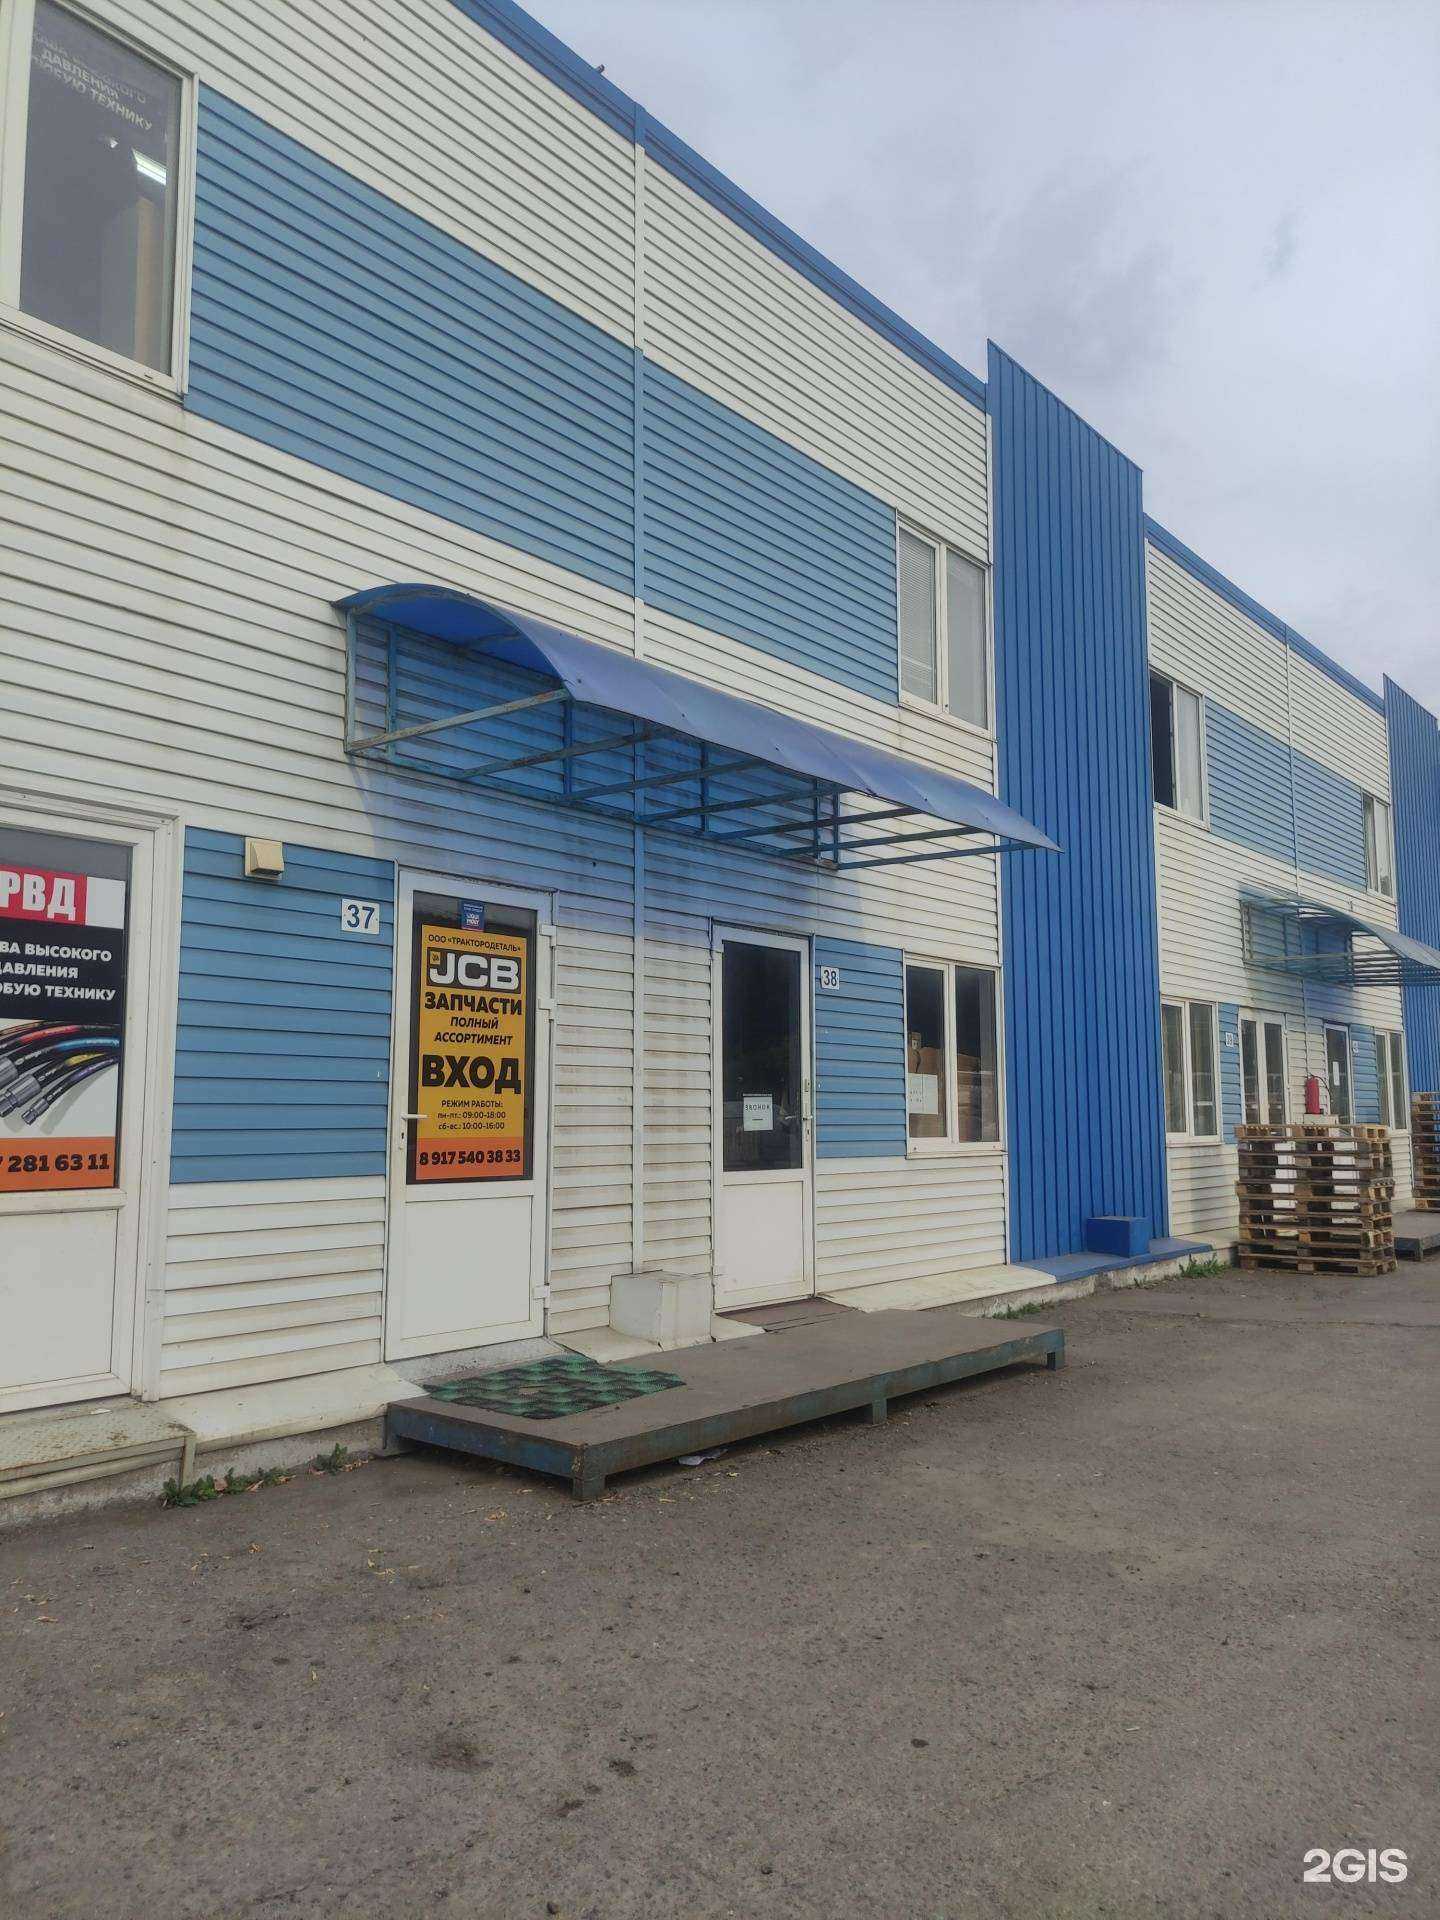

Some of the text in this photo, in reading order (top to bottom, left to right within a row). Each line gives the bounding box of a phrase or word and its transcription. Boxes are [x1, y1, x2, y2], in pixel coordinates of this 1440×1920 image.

[89, 87, 152, 130] ТЕХНИКУ
[347, 904, 375, 929] 37
[428, 934, 447, 943] ООО
[25, 943, 112, 962] ВЫСОКОГО
[0, 961, 79, 979] АВЛЕНИЯ
[429, 952, 520, 990] JCB
[823, 969, 837, 987] 38
[0, 982, 117, 1001] БУЮ ТЕХНИКУ
[424, 992, 523, 1015] ЗАПЧАСТИ
[450, 1016, 499, 1030] ПОЛНЫЙ
[434, 1032, 514, 1046] АССОРТИМЕНТ
[421, 1054, 522, 1095] ВХОД
[441, 1100, 504, 1108] РЕЖИМ РАБОТЫ:
[462, 1111, 506, 1119] 09:00-18:00
[7, 1154, 50, 1173] 281
[54, 1153, 84, 1171] 63
[87, 1153, 110, 1170] 11
[419, 1148, 521, 1166] 8 917 540 38 33
